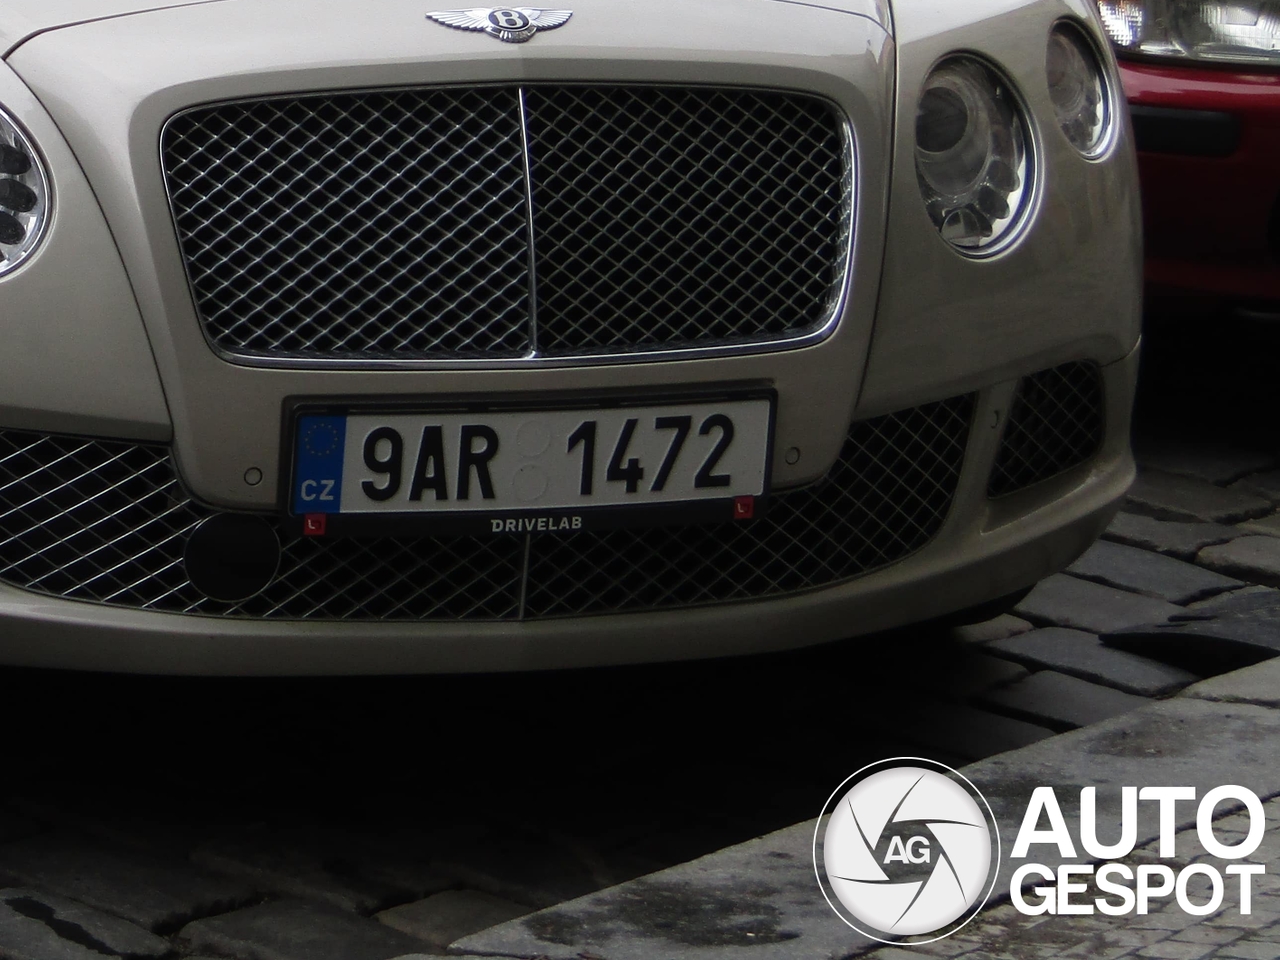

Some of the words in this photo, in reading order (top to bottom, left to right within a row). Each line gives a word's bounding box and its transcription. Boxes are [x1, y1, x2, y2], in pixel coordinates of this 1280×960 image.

[494, 11, 523, 28] B
[361, 425, 499, 501] 9AR
[567, 414, 734, 495] 1472
[301, 479, 335, 500] CZ
[491, 516, 582, 532] DRIVELAB
